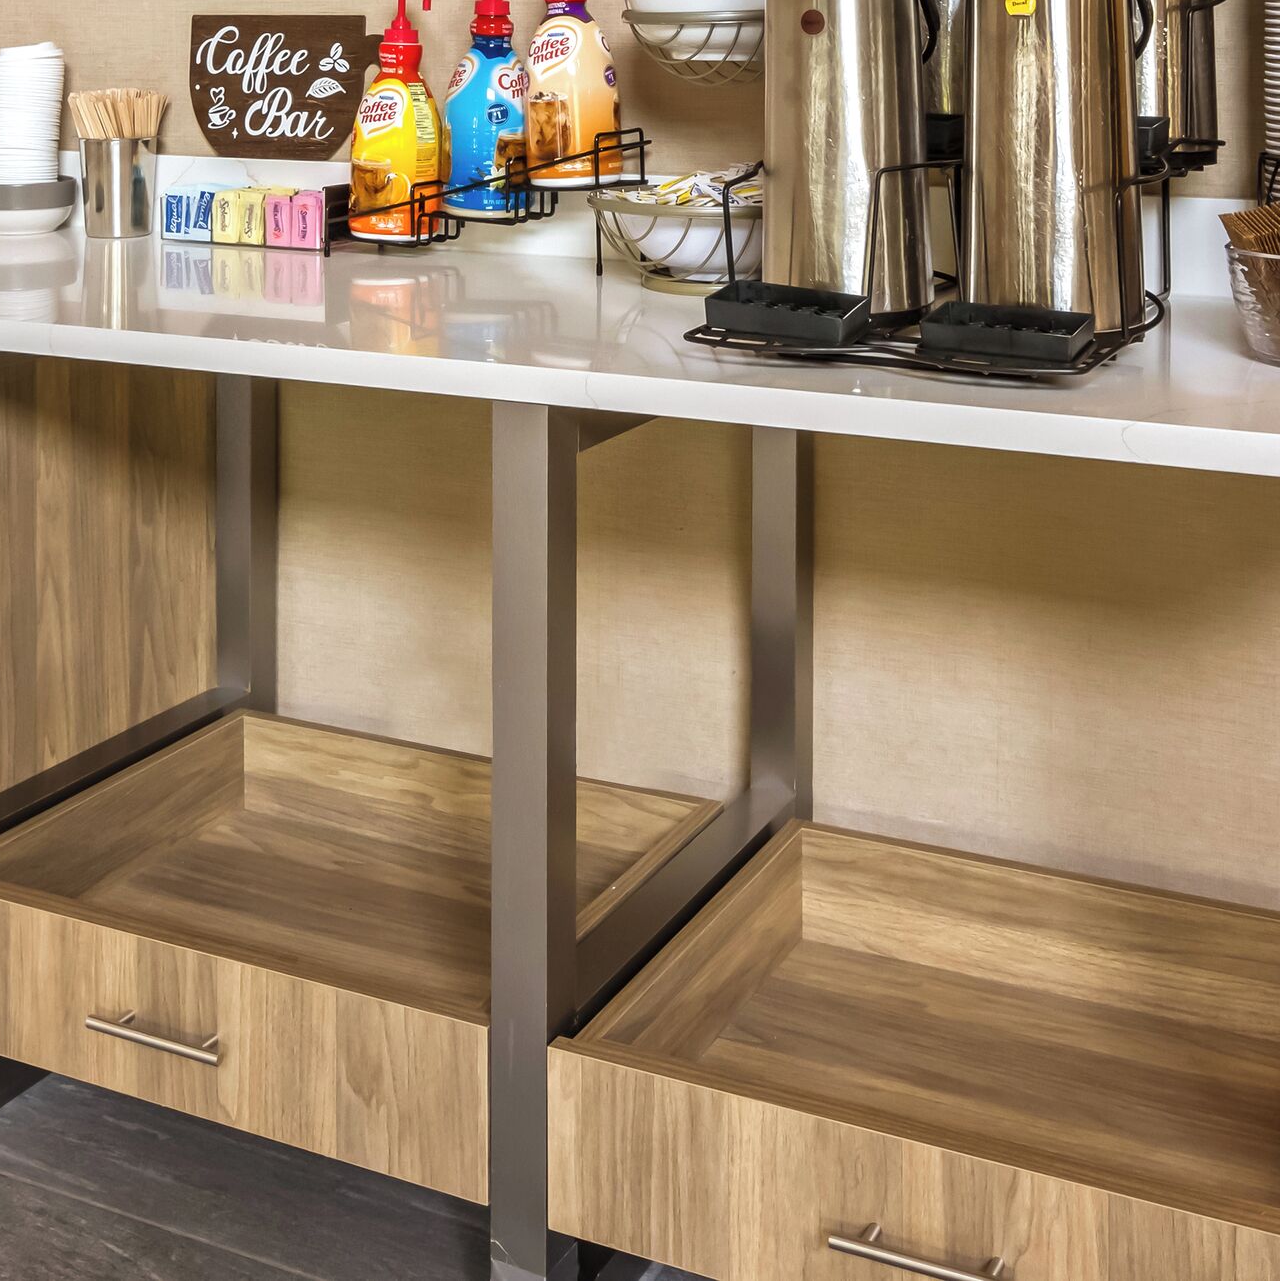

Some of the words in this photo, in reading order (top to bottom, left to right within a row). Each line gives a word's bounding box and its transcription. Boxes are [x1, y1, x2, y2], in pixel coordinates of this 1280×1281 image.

[528, 36, 570, 58] Coffee
[533, 45, 570, 66] mate
[196, 25, 310, 94] Coffee
[497, 72, 524, 90] Coff
[244, 86, 335, 140] Bar
[359, 98, 398, 115] Coffee
[361, 110, 397, 124] mate
[167, 194, 182, 233] equal
[196, 191, 211, 229] equal
